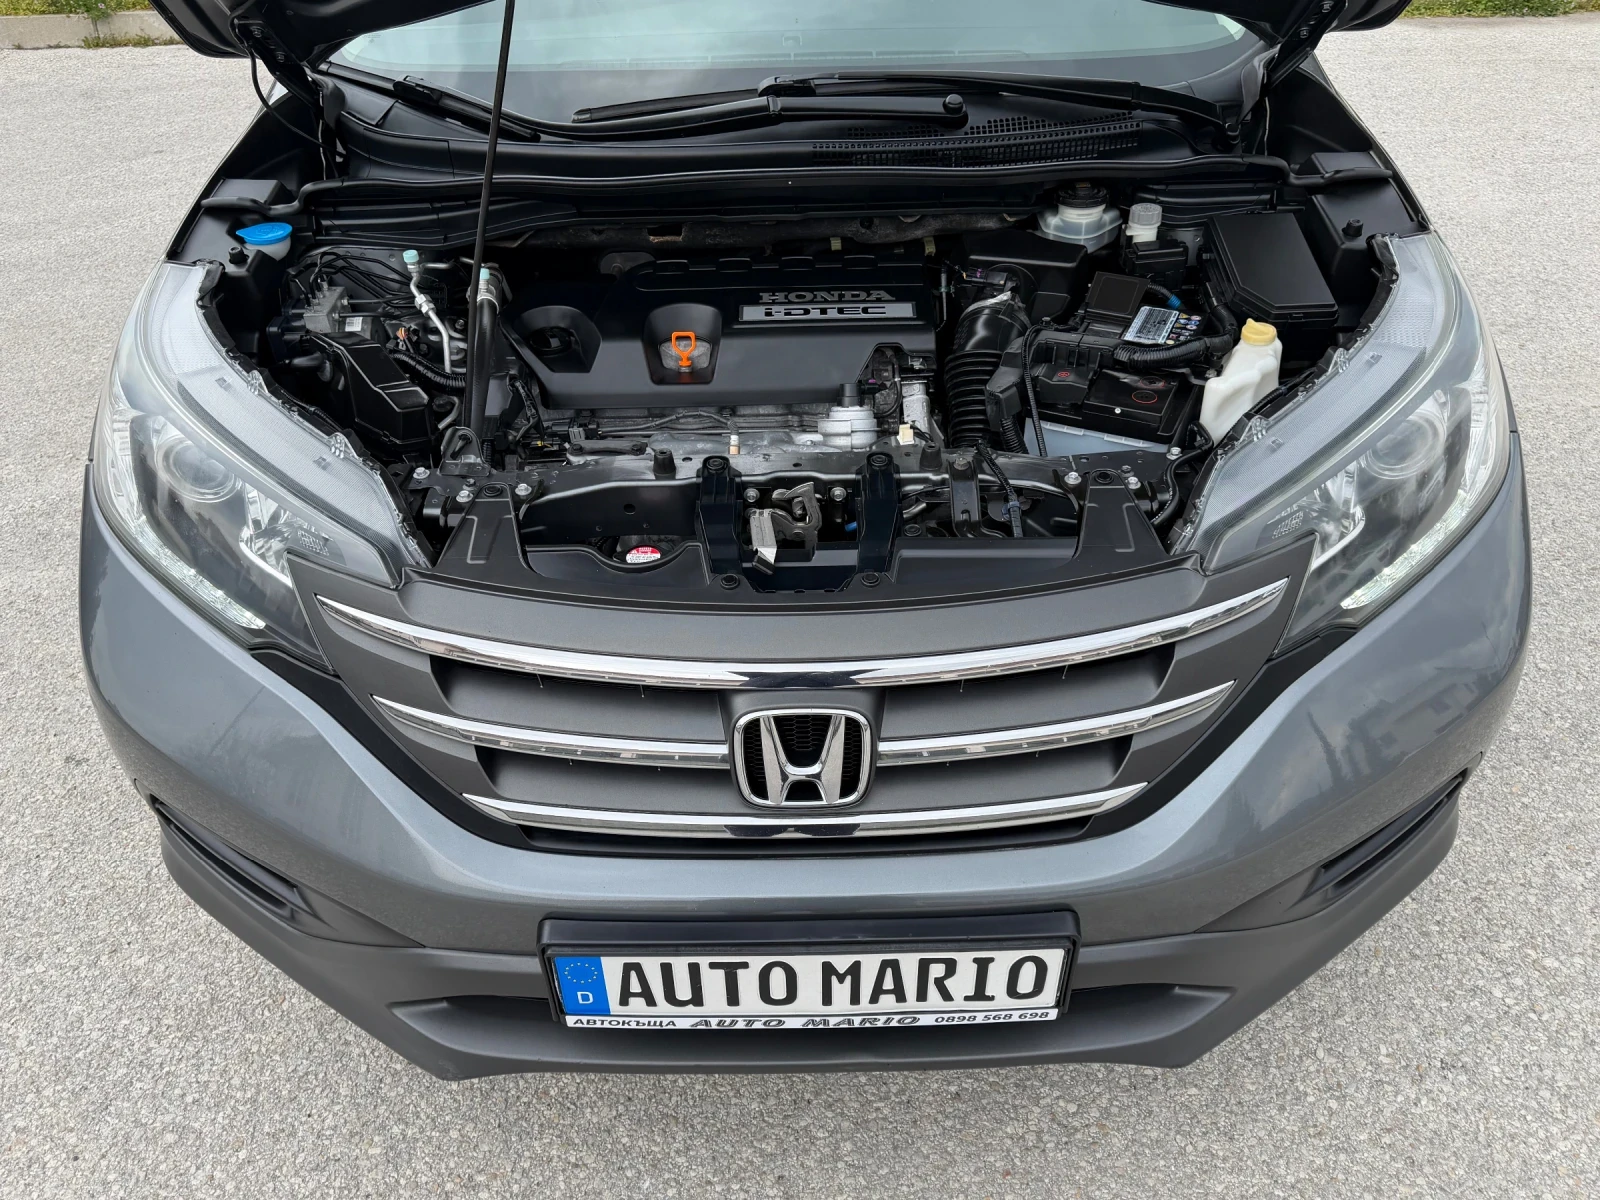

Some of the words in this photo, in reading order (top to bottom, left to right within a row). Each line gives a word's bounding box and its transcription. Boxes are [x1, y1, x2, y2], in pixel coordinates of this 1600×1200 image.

[759, 290, 896, 303] HONDA
[619, 960, 798, 1008] AUTO
[821, 955, 1048, 1007] MARIO
[577, 991, 594, 1005] D
[573, 1018, 677, 1028] АВТОКЪЩА
[690, 1018, 786, 1028] AUTO
[800, 1015, 921, 1028] MARIO
[934, 1014, 976, 1024] 0898
[982, 1012, 1013, 1022] 568
[1018, 1011, 1050, 1020] 698
